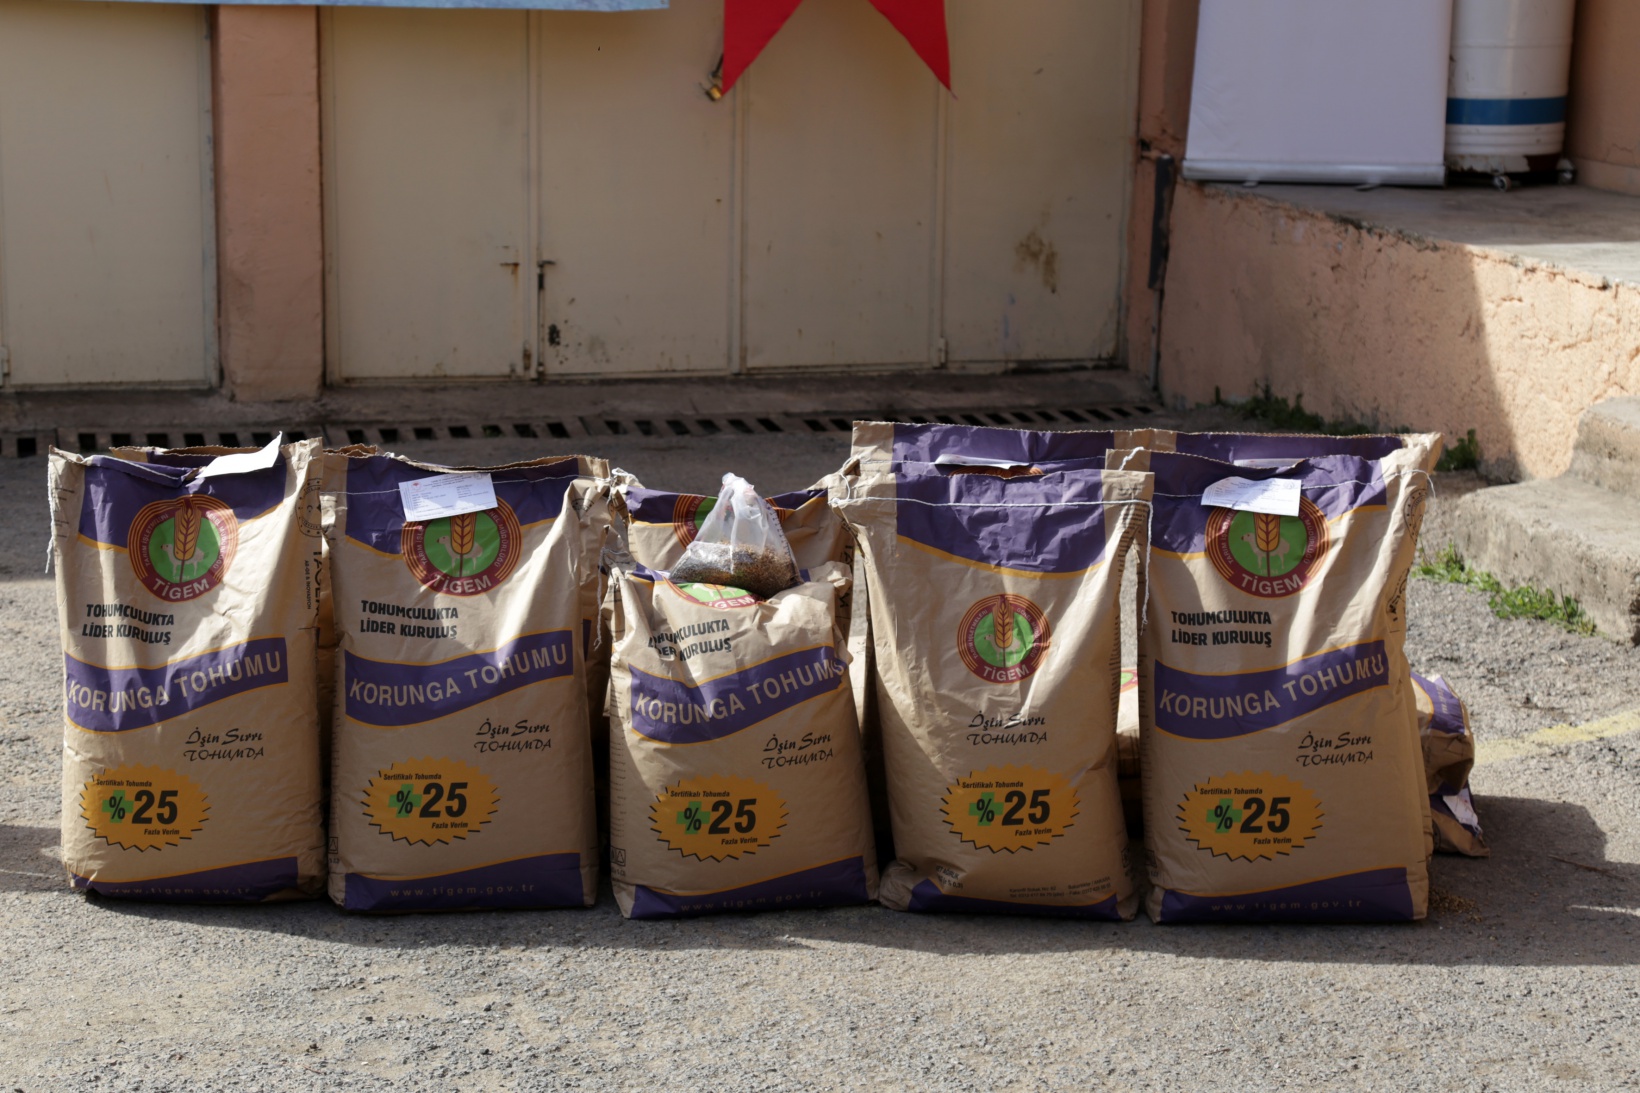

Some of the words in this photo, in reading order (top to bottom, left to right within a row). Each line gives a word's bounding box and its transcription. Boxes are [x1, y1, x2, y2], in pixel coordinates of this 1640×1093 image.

[152, 578, 210, 600] TİGEM
[433, 574, 492, 593] TİGEM
[1241, 573, 1303, 595] TİGEM
[361, 600, 459, 620] TOHUMCULUKTA
[708, 597, 756, 610] İGEM
[86, 604, 174, 626] TOHUMCULUKTA
[1171, 610, 1272, 626] TOHUMCULUKTA
[82, 623, 114, 638] LİDER
[116, 624, 171, 645] KURULUŞ
[360, 617, 396, 634] LİDER
[400, 622, 458, 640] KURULUŞ
[1171, 629, 1208, 646] LİDER
[1212, 630, 1272, 648] KURULUŞ
[350, 678, 462, 706] KORUNGA
[464, 643, 568, 689] TOHUMU
[983, 664, 1029, 681] TİGEM
[68, 680, 170, 713] KORUNGA
[174, 651, 282, 697] TOHUMU
[1159, 689, 1281, 719] KORUNGA
[1282, 654, 1385, 702] TOHUMU
[635, 692, 746, 725] KORUNGA
[185, 727, 220, 747] İşin
[475, 718, 510, 738] İşin
[473, 738, 552, 753] TOHUMDA
[763, 734, 797, 754] İşin
[966, 731, 1048, 745] TOHUMDA
[1298, 731, 1333, 752] İşin
[183, 747, 265, 762] TOHUMDA
[761, 748, 834, 769] TOHUMDA
[1296, 751, 1374, 767] TOHUMDA
[126, 780, 152, 788] Tohumda
[995, 780, 1024, 788] Tohumda
[1233, 787, 1263, 795] Tohumda
[702, 790, 730, 798] Tohumda
[144, 828, 161, 836] Fazla
[162, 828, 180, 836] Verim
[431, 822, 449, 830] Fazla
[450, 821, 469, 829] Verim
[1014, 829, 1033, 837] Fazla
[1033, 827, 1052, 836] Verim
[739, 836, 758, 844] Verim
[1253, 837, 1272, 845] Fazla
[1272, 836, 1292, 844] Verim
[390, 883, 535, 897] www.tigem.gov.tr
